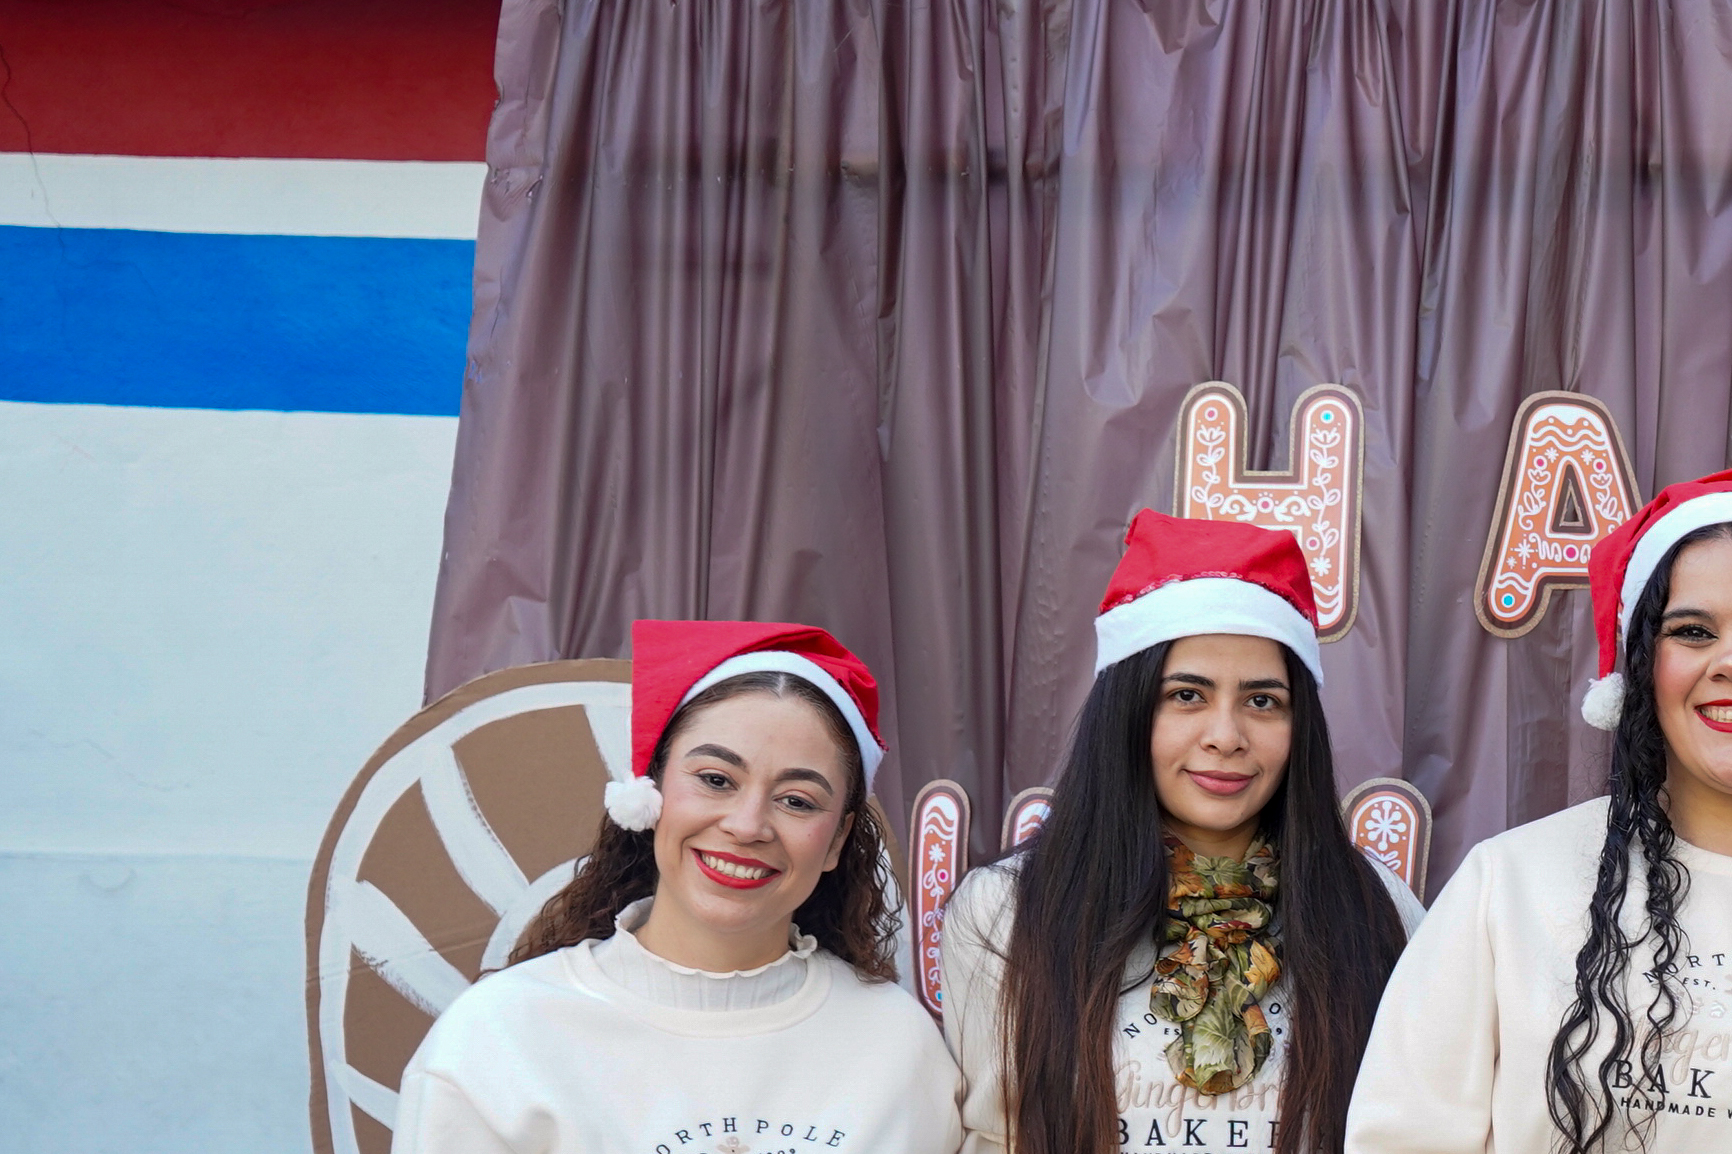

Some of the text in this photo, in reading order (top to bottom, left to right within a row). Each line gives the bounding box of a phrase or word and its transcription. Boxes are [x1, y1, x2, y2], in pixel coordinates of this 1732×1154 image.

[1682, 976, 1716, 990] EST.
[1620, 1096, 1717, 1119] HANDMADE
[756, 1119, 846, 1149] POLE
